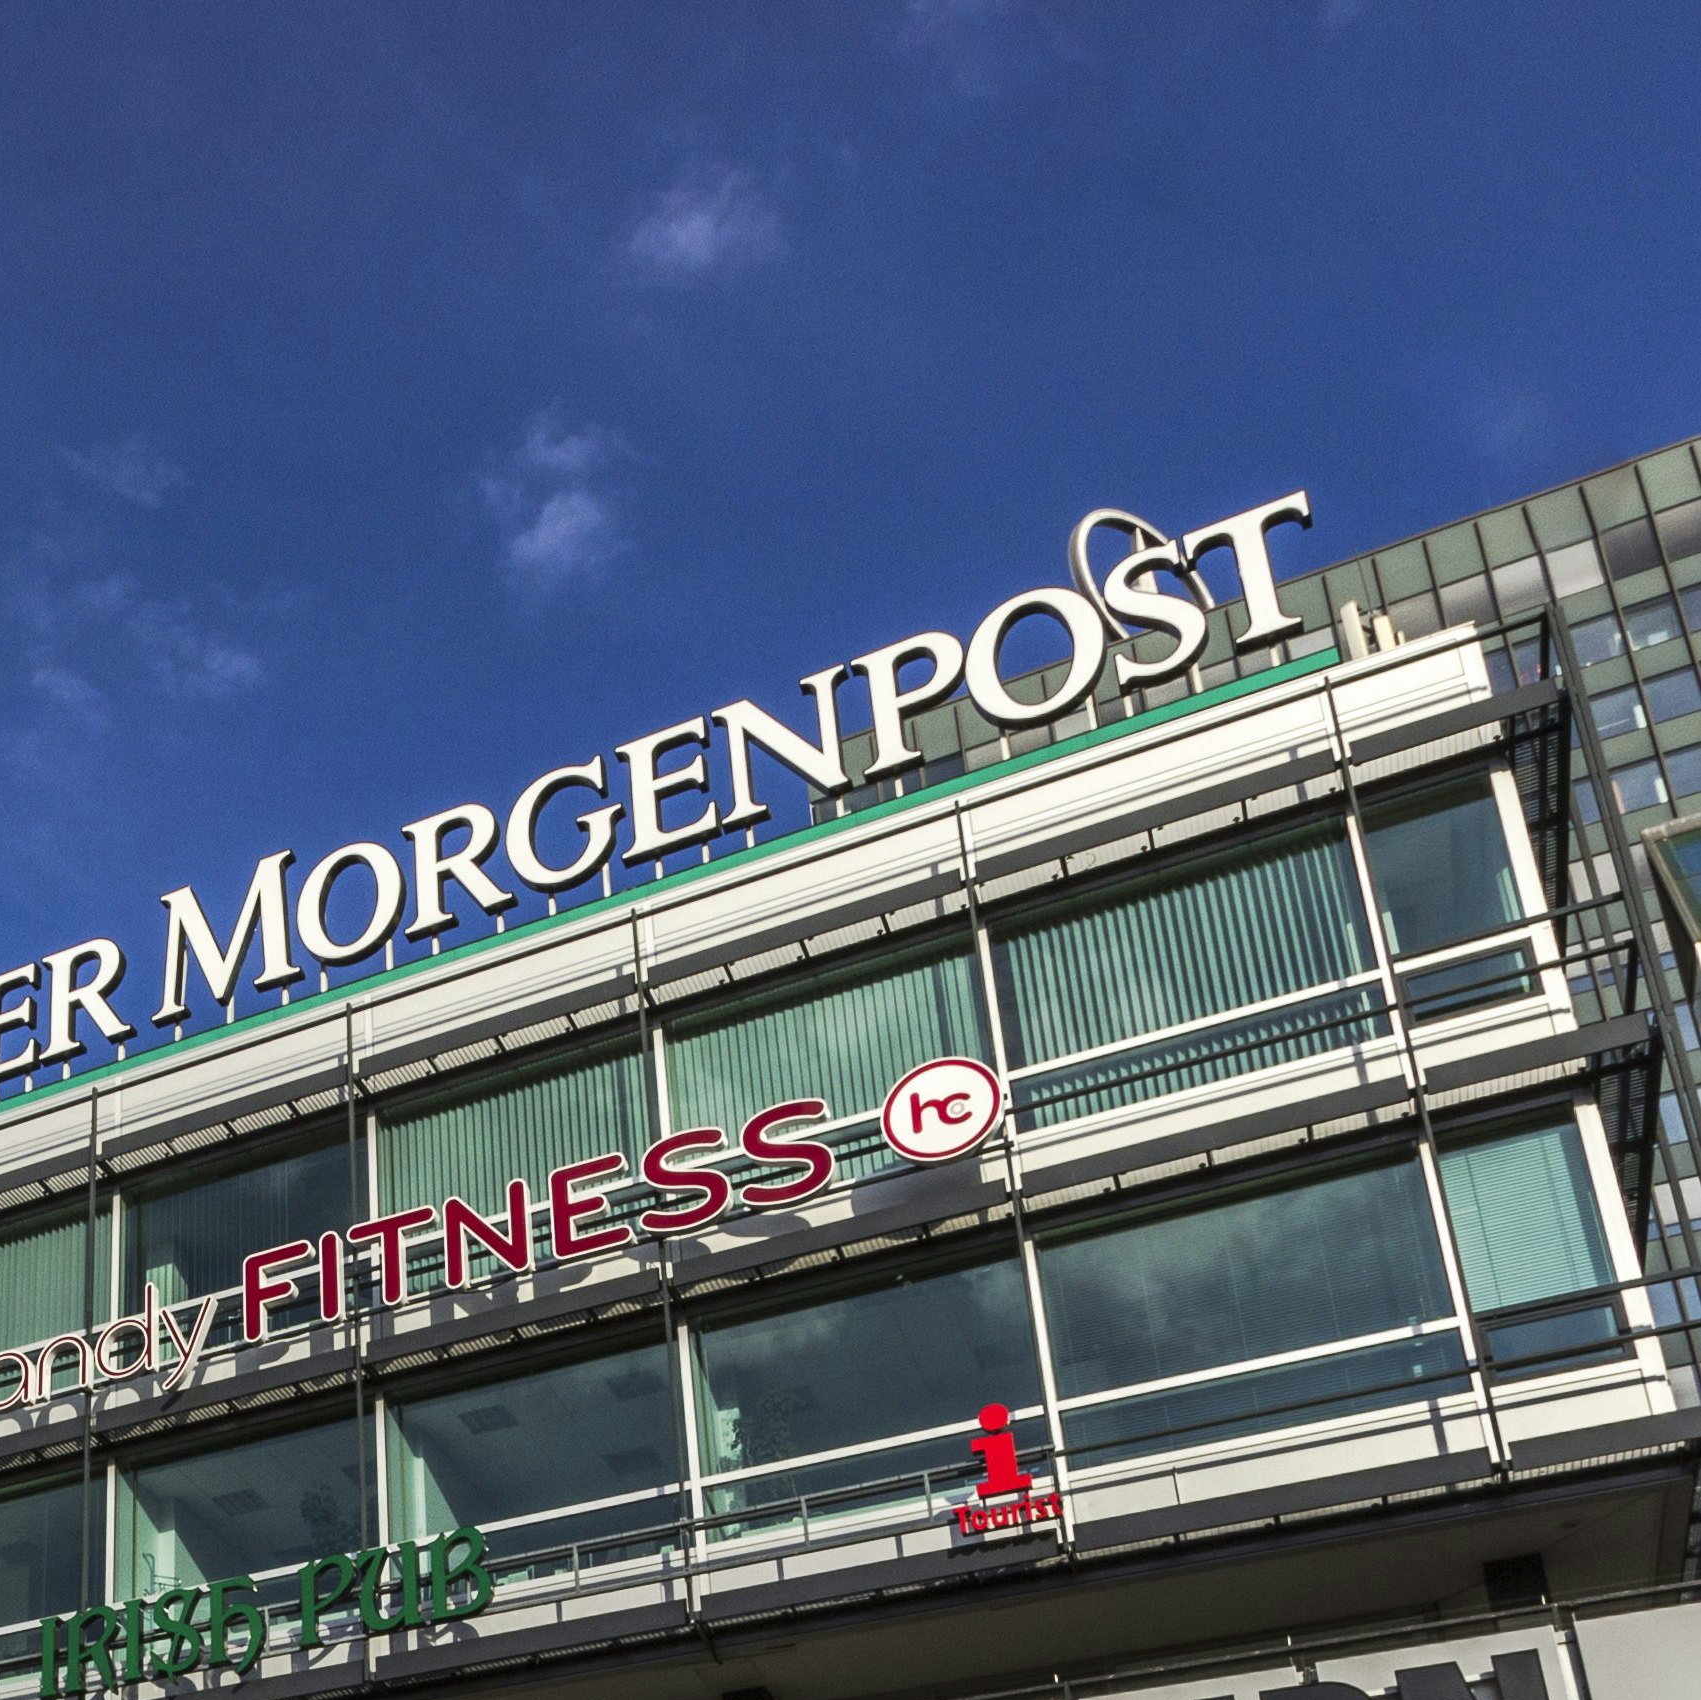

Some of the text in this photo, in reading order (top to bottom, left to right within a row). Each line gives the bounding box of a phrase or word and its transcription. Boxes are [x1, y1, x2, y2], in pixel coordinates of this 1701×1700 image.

[151, 489, 1312, 1027] MORGENPOST
[243, 1098, 835, 1343] FITNESS
[40, 1526, 496, 1700] IRISH PUB
[953, 1491, 1063, 1536] Tourist
